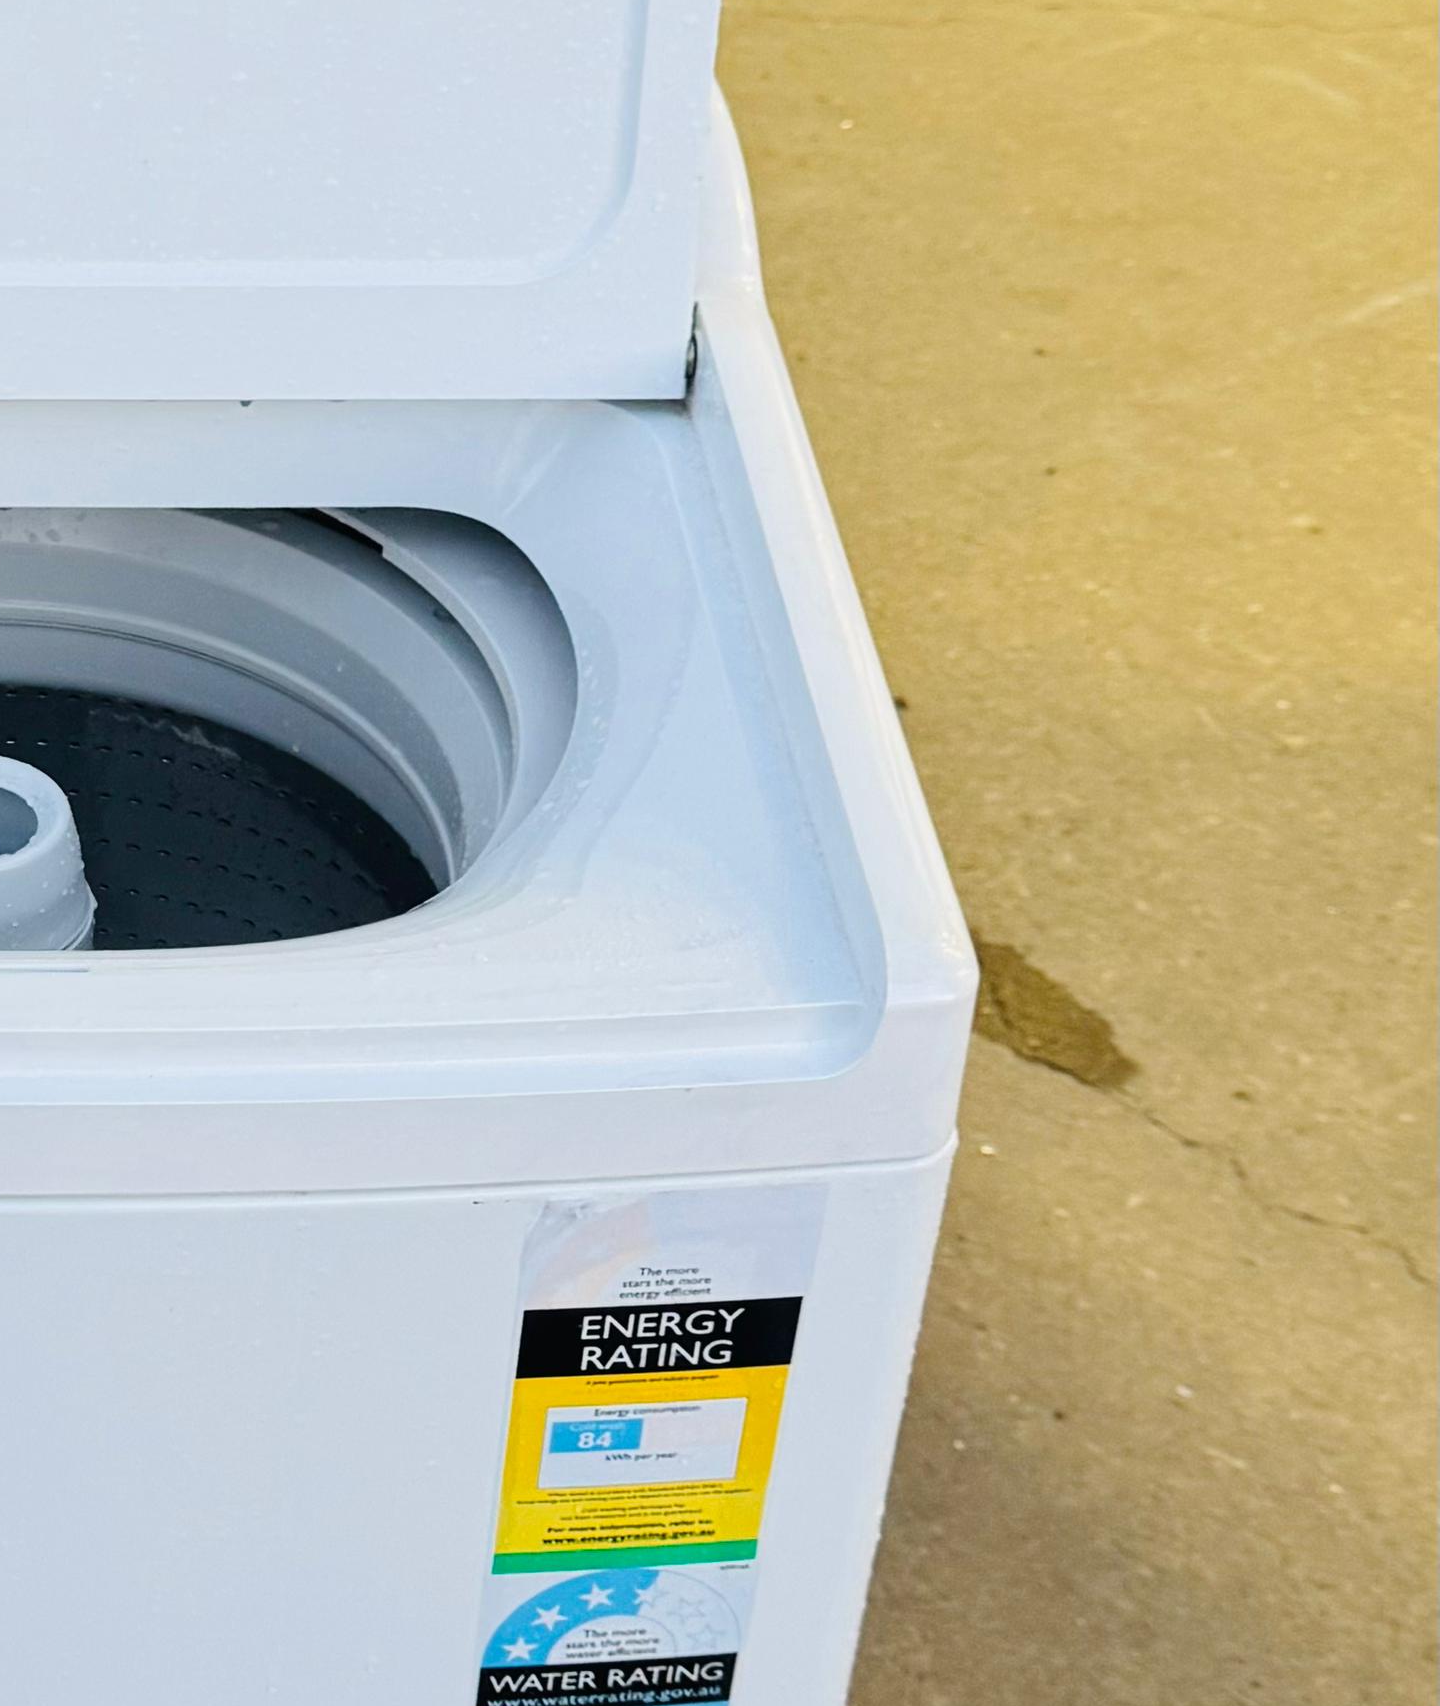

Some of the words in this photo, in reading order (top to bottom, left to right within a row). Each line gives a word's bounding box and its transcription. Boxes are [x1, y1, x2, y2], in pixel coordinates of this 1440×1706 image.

[640, 1267, 662, 1276] The
[665, 1267, 699, 1276] more
[622, 1280, 651, 1288] stars
[655, 1278, 675, 1286] the
[678, 1277, 712, 1285] more
[619, 1291, 660, 1300] energy
[580, 1308, 746, 1340] ENERGY
[580, 1339, 734, 1371] RATING
[593, 1408, 629, 1418] Energy
[576, 1431, 613, 1449] 84
[584, 1629, 608, 1638] The
[489, 1670, 597, 1693] WATER
[607, 1661, 725, 1688] RATING
